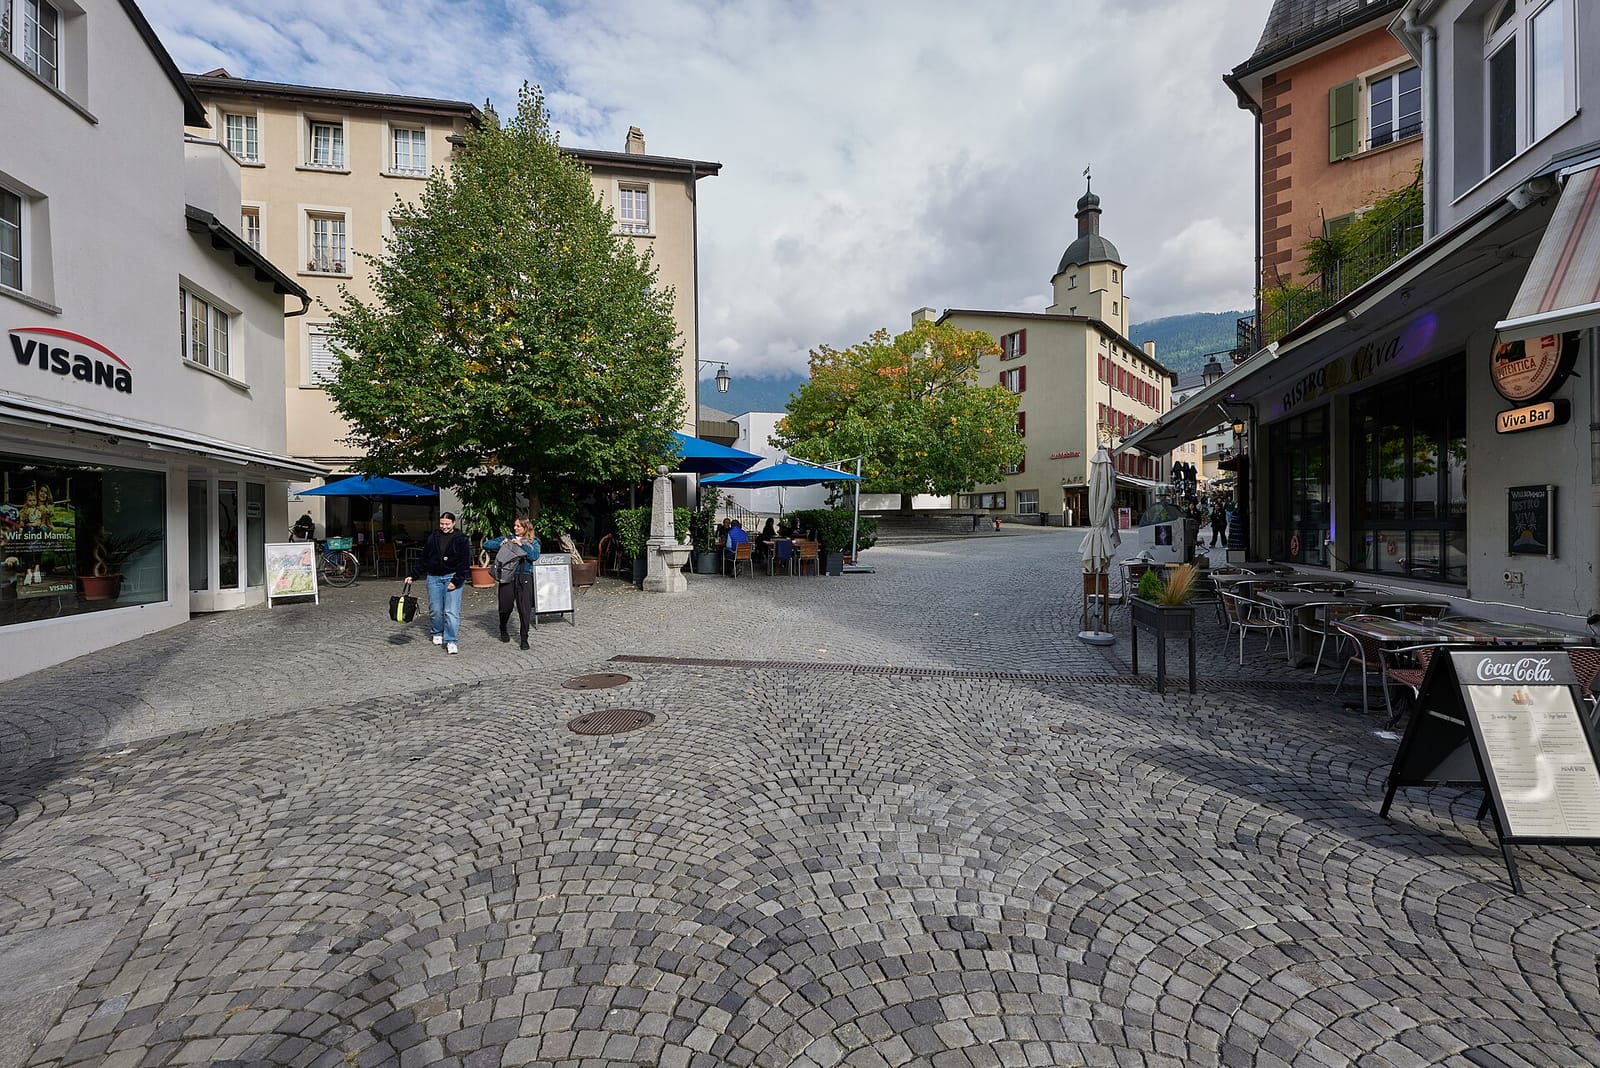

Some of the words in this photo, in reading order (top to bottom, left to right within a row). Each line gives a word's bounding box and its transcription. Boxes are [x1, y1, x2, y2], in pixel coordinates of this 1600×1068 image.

[1282, 367, 1326, 412] BISTRO
[1351, 336, 1404, 382] Viva
[1502, 413, 1526, 428] Viva
[1529, 408, 1551, 423] Bar
[5, 531, 22, 540] Wir
[24, 531, 42, 540] sind
[44, 531, 73, 540] Mamis.
[1477, 657, 1553, 681] Coca-Cola
